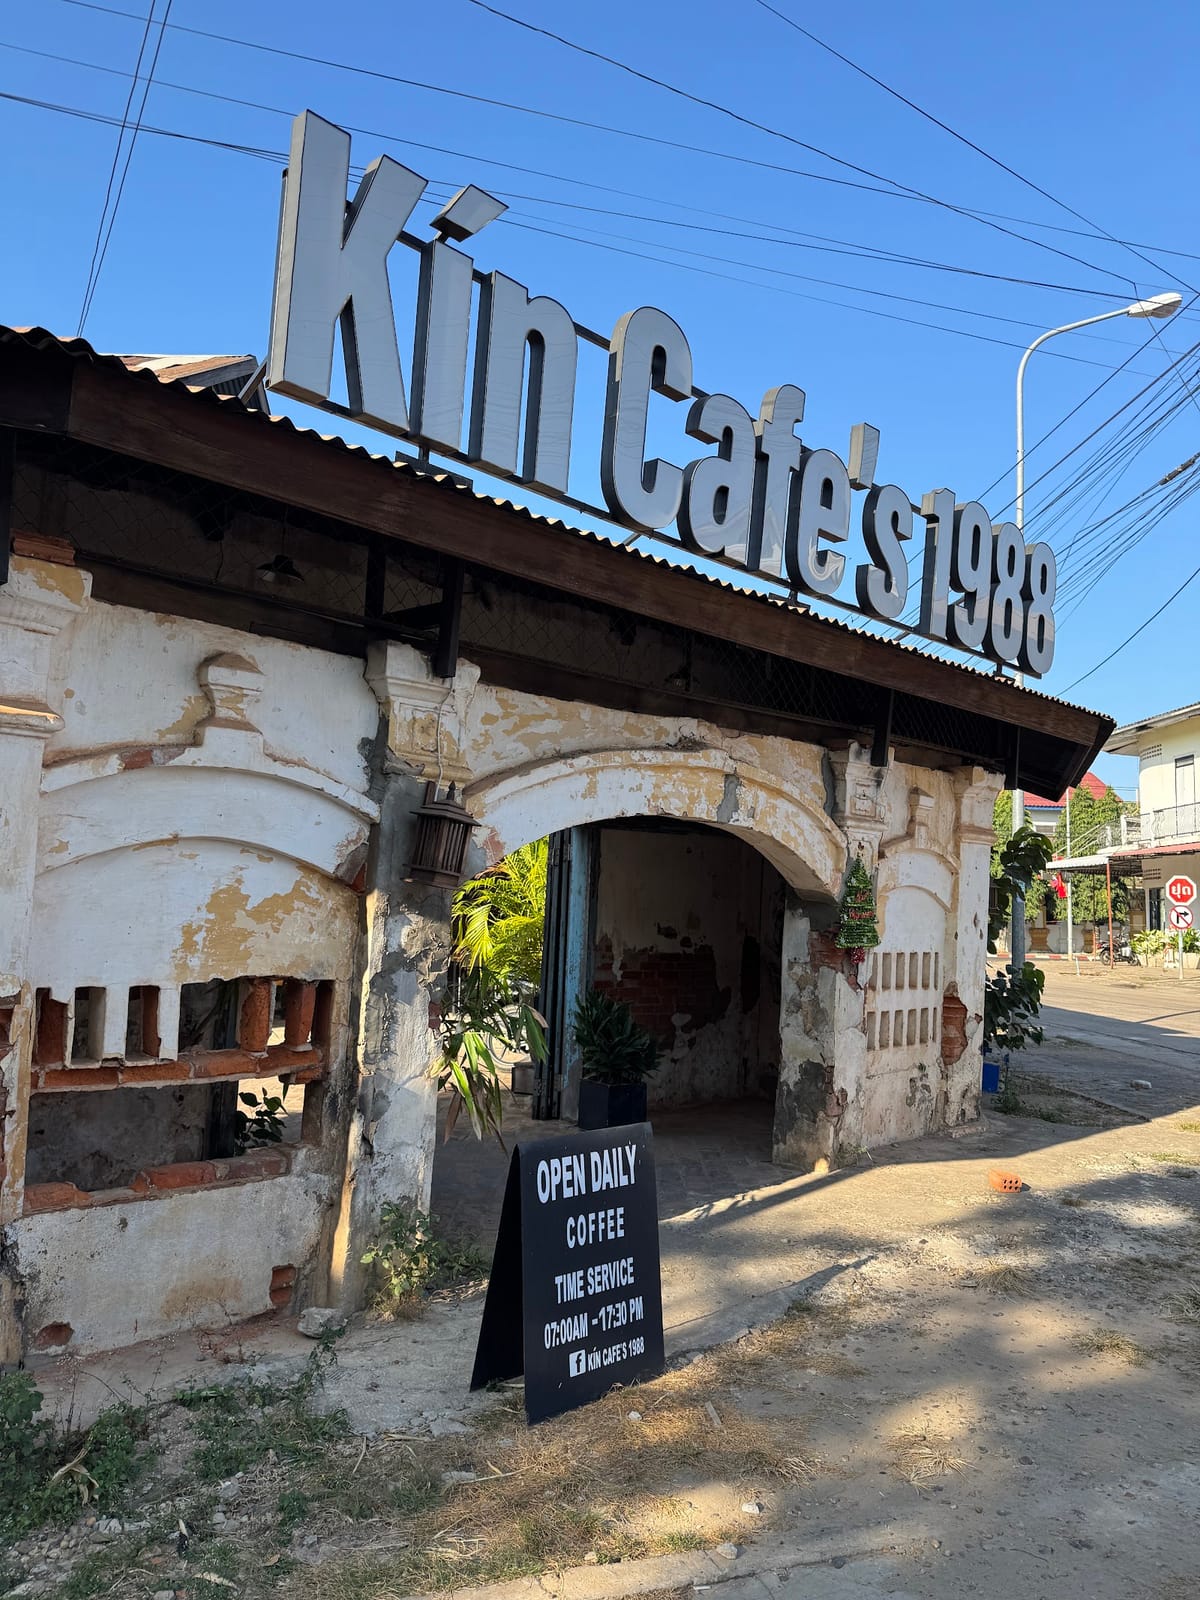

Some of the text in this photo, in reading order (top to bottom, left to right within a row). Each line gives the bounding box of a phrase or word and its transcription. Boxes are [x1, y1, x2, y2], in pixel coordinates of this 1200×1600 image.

[920, 487, 1057, 674] 1988
[537, 1144, 637, 1204] OPEN DAILY
[566, 1206, 625, 1249] COFFEE
[554, 1256, 635, 1304] TIME SERVICE
[544, 1312, 589, 1350] 07:00AM
[629, 1295, 644, 1323] PM
[587, 1346, 601, 1372] KÍN
[602, 1342, 627, 1367] CAFE'S
[629, 1336, 645, 1357] 1988
